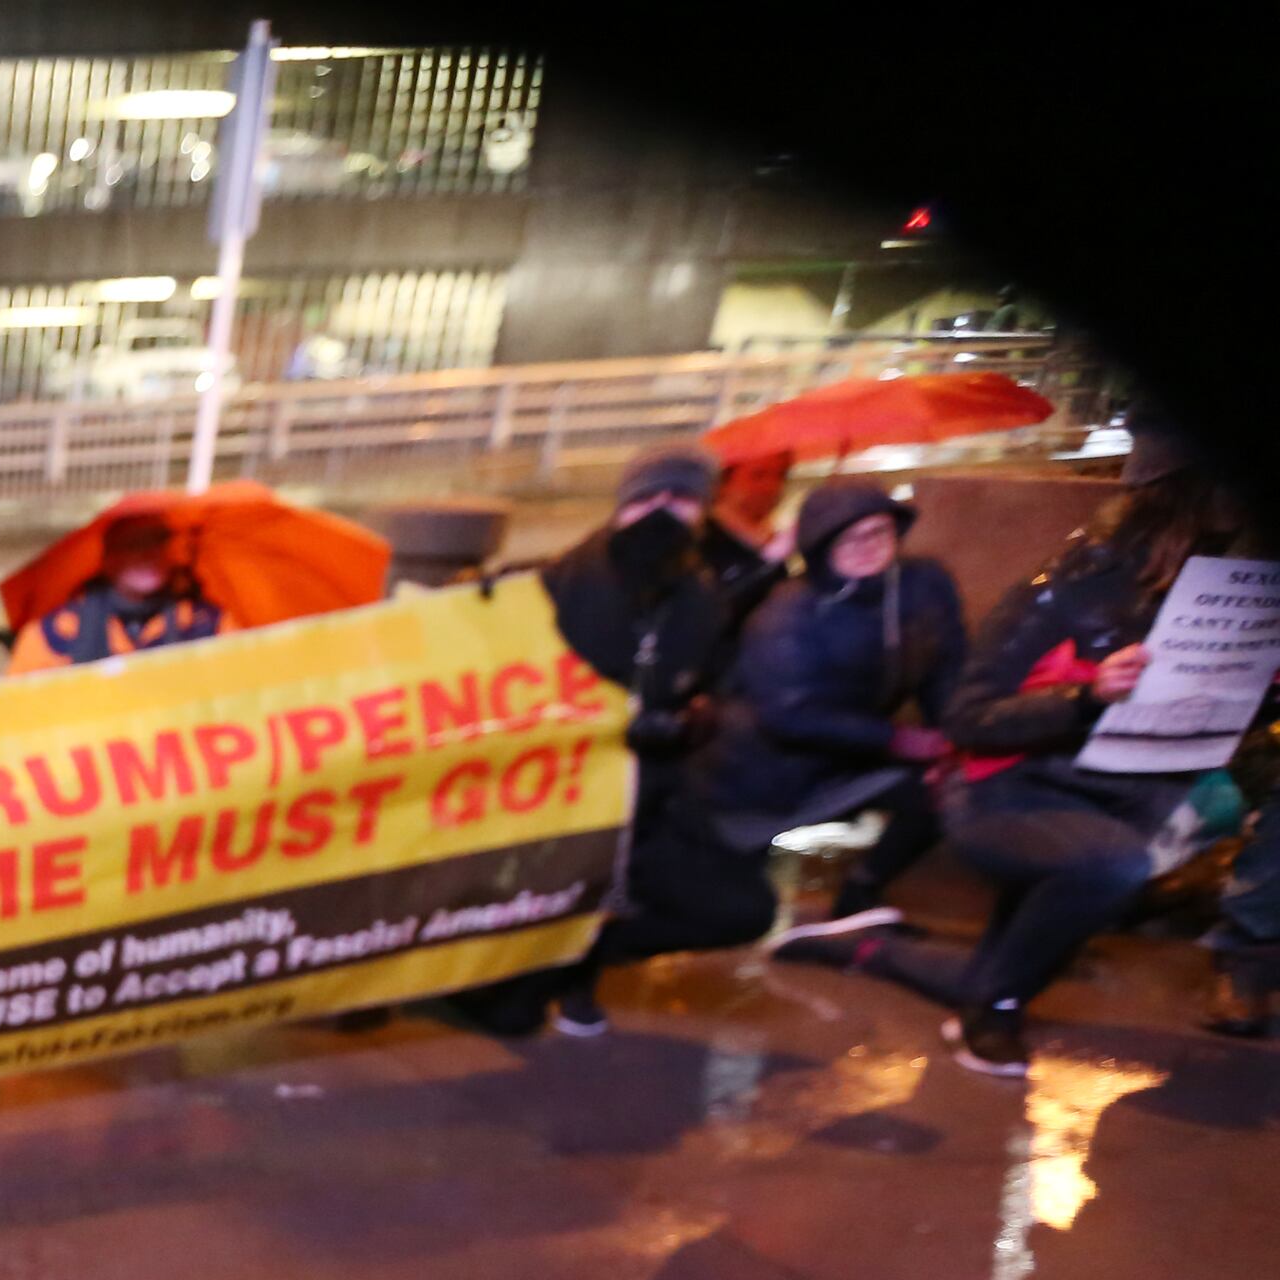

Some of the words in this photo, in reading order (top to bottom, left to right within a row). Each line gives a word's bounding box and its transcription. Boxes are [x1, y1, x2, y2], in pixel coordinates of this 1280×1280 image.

[126, 775, 405, 898] MUST
[428, 737, 594, 829] GO!
[67, 983, 107, 1014] to
[113, 949, 247, 1004] Accept
[253, 947, 280, 977] a
[285, 915, 420, 971] Fascist
[73, 939, 115, 979] of
